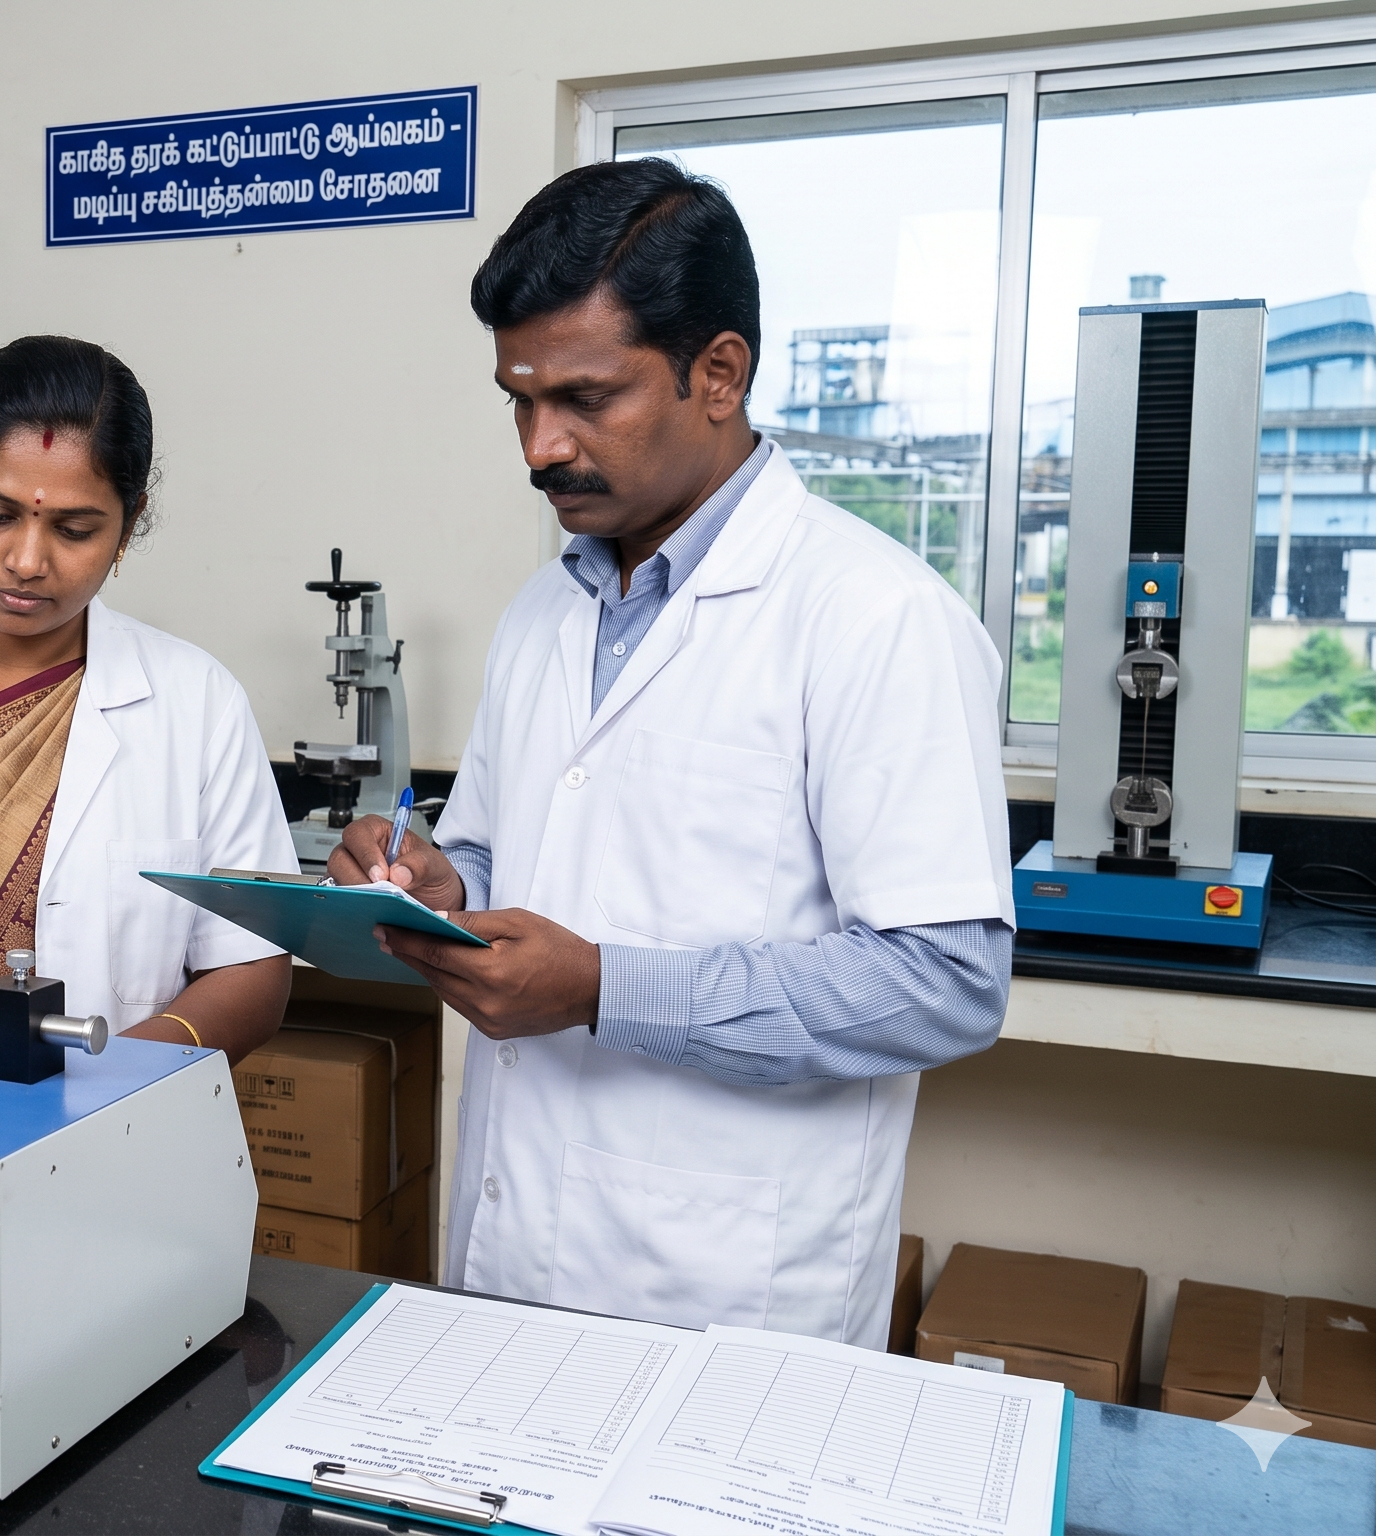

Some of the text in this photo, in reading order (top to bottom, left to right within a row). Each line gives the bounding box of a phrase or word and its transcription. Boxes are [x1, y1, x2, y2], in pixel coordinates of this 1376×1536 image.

[59, 139, 126, 179] காகித
[131, 133, 181, 178] தரக்
[187, 122, 321, 168] கட்டுப்பாட்டு
[325, 107, 445, 157] ஆய்வகம்
[73, 168, 442, 224] மடிப்பு சகிப்புத்தன்மை சோதனை
